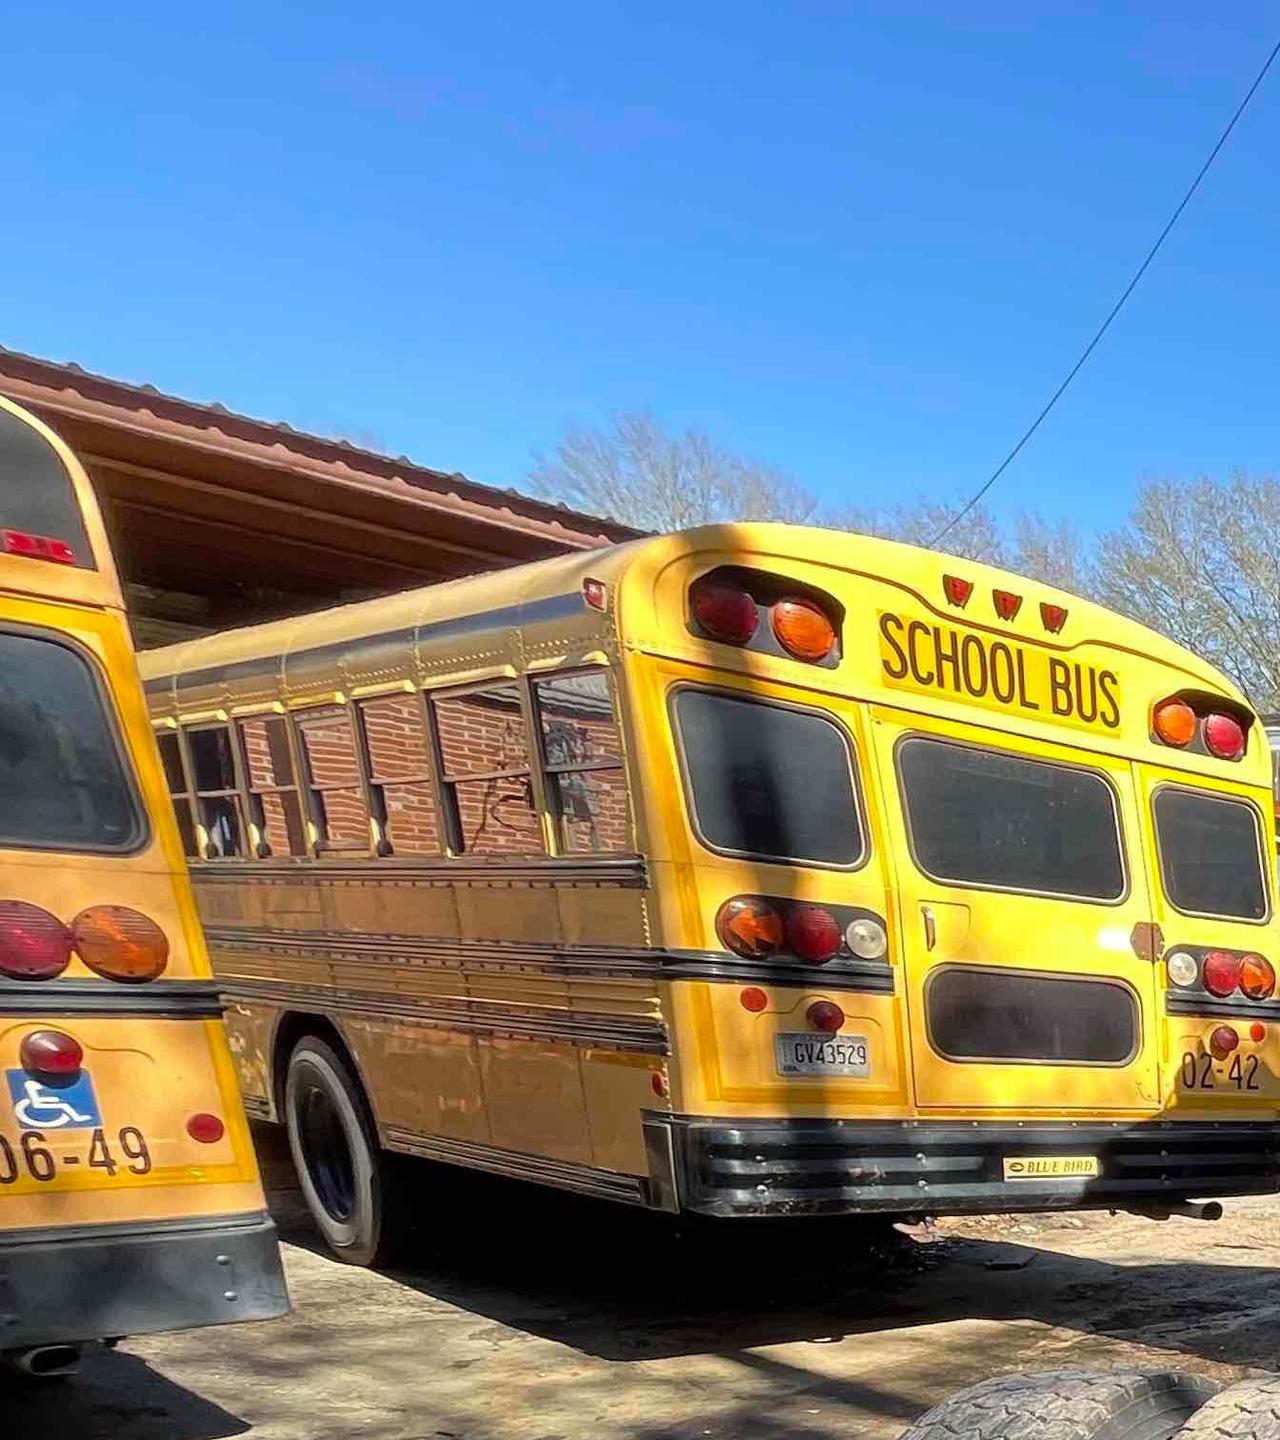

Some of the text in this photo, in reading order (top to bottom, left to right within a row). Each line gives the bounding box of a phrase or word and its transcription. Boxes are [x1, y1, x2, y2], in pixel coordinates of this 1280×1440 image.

[879, 613, 1120, 728] SCHOOL BUS
[795, 1043, 866, 1064] GV43529
[1182, 1052, 1258, 1089] 02-42
[1028, 1161, 1092, 1172] BLUE BIRD
